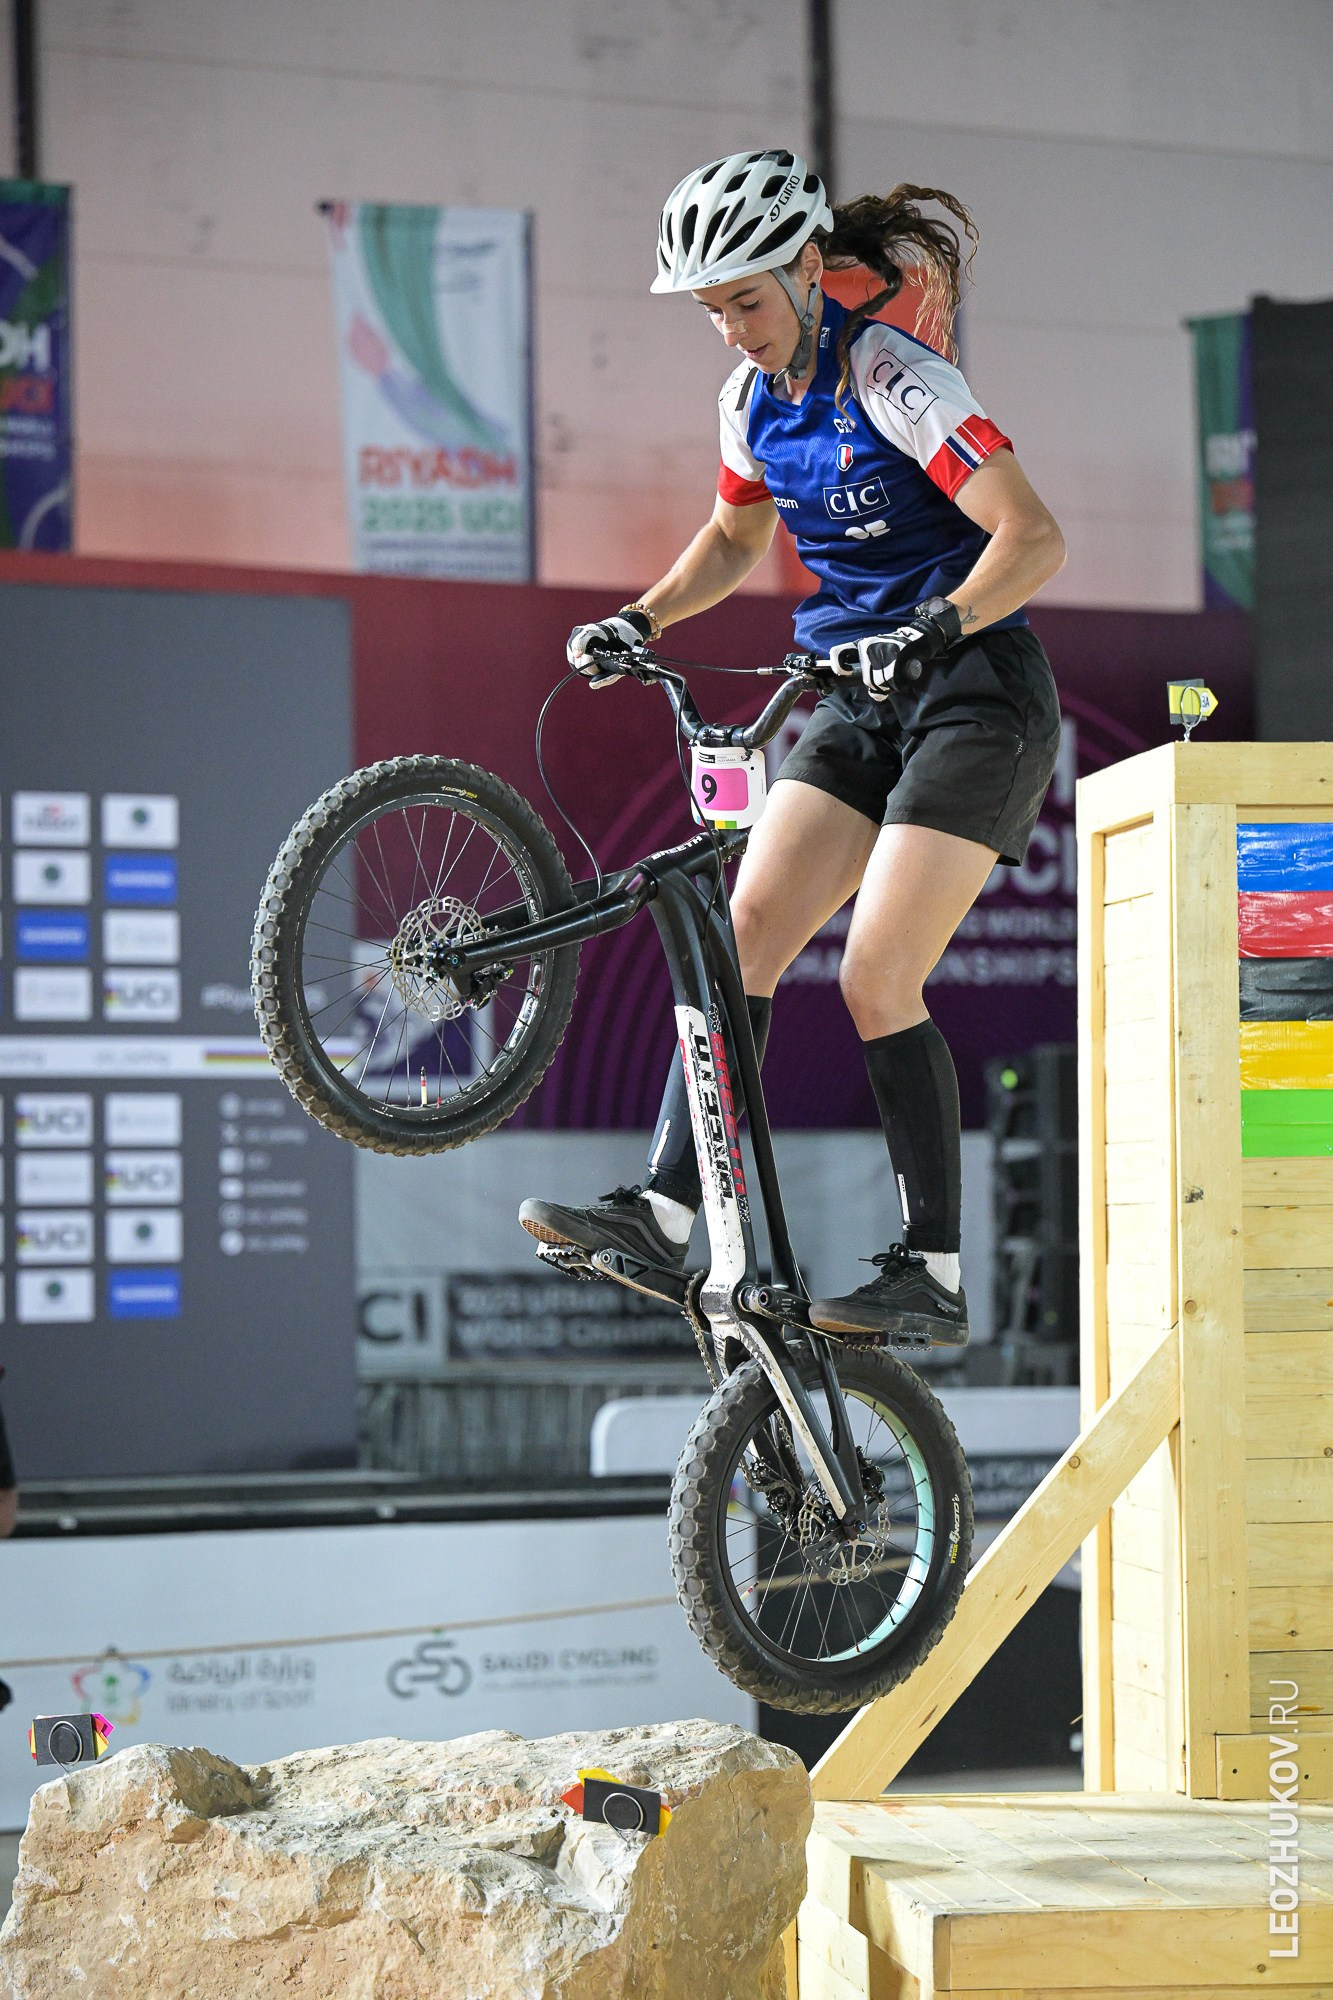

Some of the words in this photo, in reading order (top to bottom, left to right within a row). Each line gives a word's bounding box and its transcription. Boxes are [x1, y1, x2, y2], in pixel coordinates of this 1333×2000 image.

[778, 175, 801, 206] GIRO
[872, 360, 927, 411] CIC
[829, 485, 880, 513] CIC
[702, 774, 718, 805] 9
